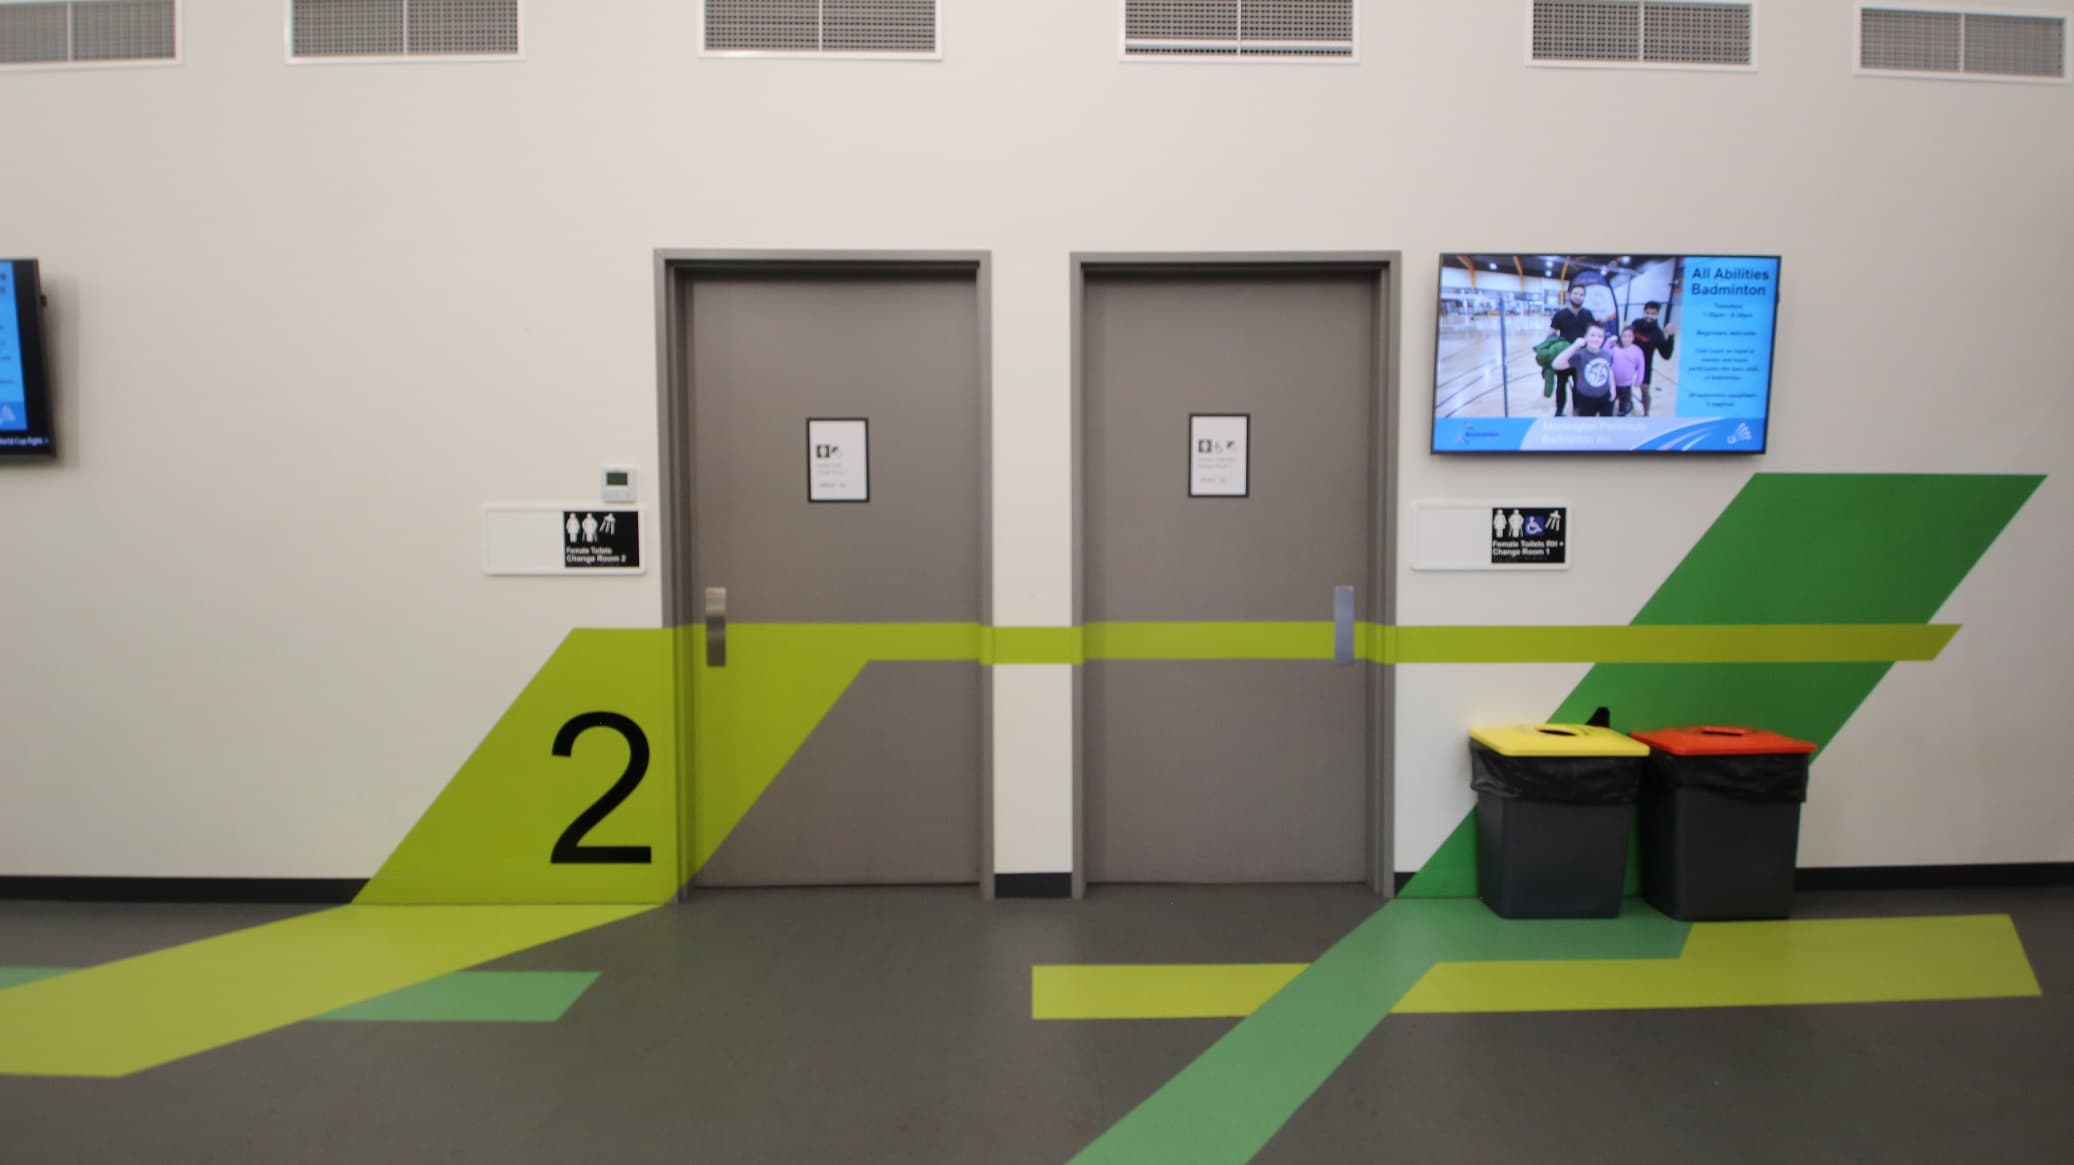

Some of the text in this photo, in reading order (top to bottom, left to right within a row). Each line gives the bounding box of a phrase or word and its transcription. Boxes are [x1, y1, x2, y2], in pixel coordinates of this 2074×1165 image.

[1691, 267, 1770, 281] All Abilities
[1690, 282, 1767, 296] Badminton
[1493, 540, 1519, 548] Female
[1521, 540, 1545, 548] Toilets
[566, 546, 614, 554] Female Toilets
[1493, 548, 1520, 557] Change
[1522, 548, 1545, 556] Room
[566, 553, 627, 564] Change Room 2
[551, 711, 652, 864] 2
